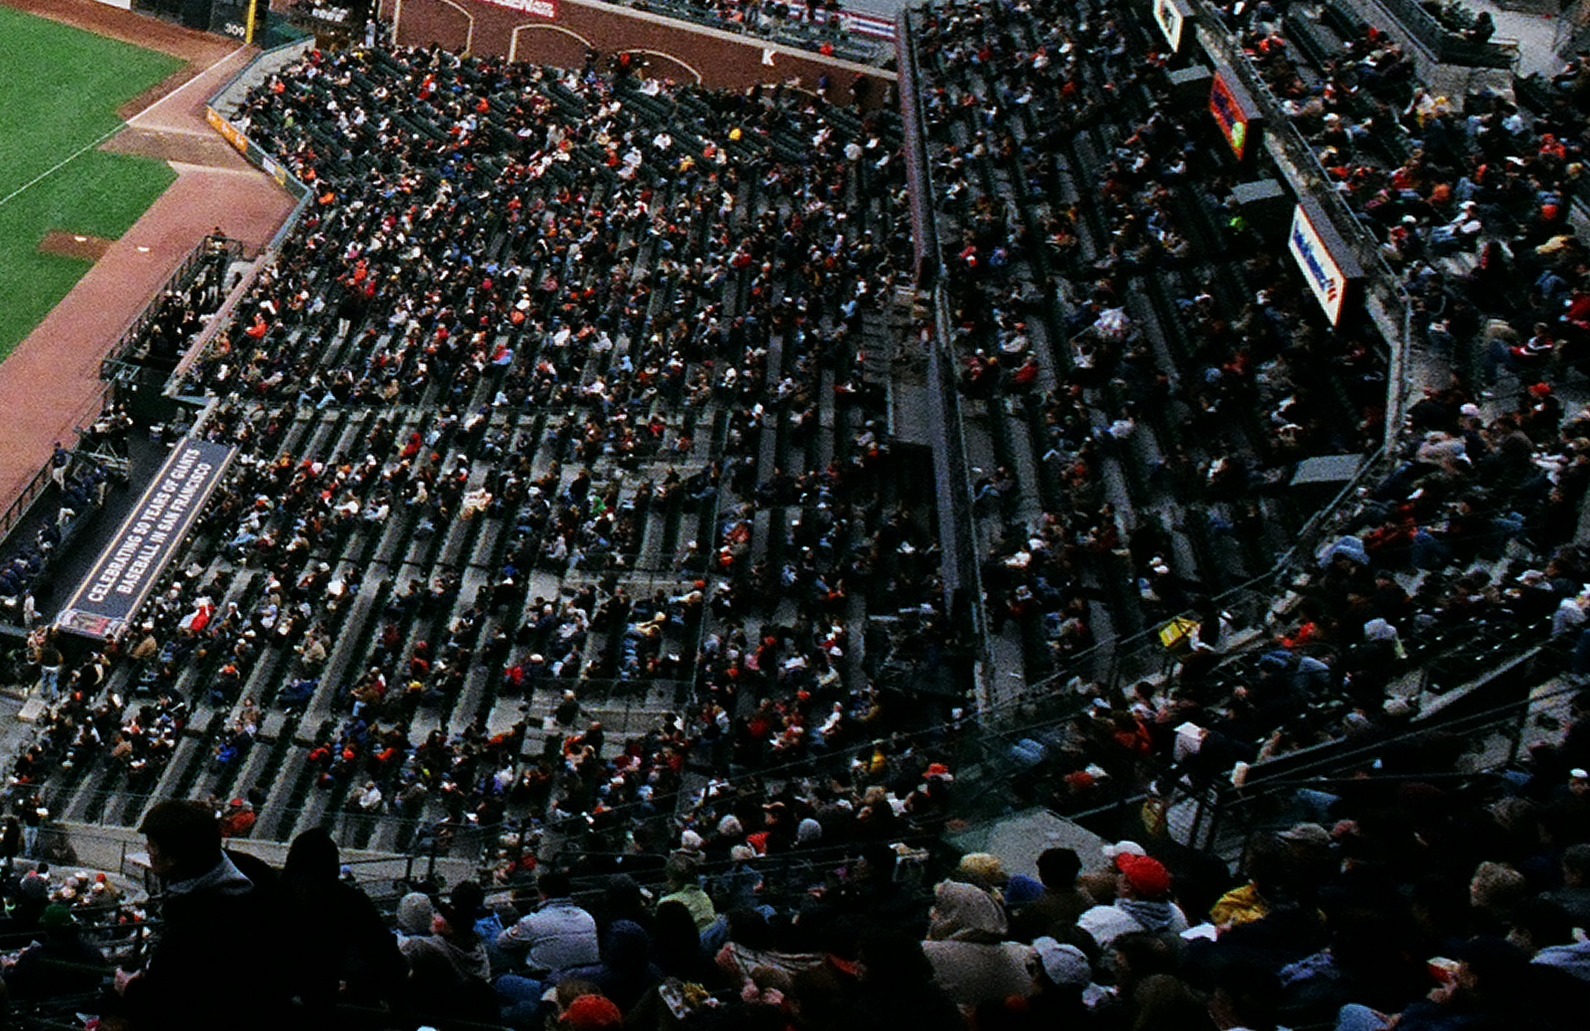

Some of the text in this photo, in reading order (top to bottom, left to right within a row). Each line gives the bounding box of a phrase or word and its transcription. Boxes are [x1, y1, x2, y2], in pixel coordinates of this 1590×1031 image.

[224, 22, 246, 37] 309
[88, 448, 201, 603] CELEBRATING 50 YEARS OF GIANTS
[117, 463, 212, 594] BASEBALL IN SAN FRANCISCO
